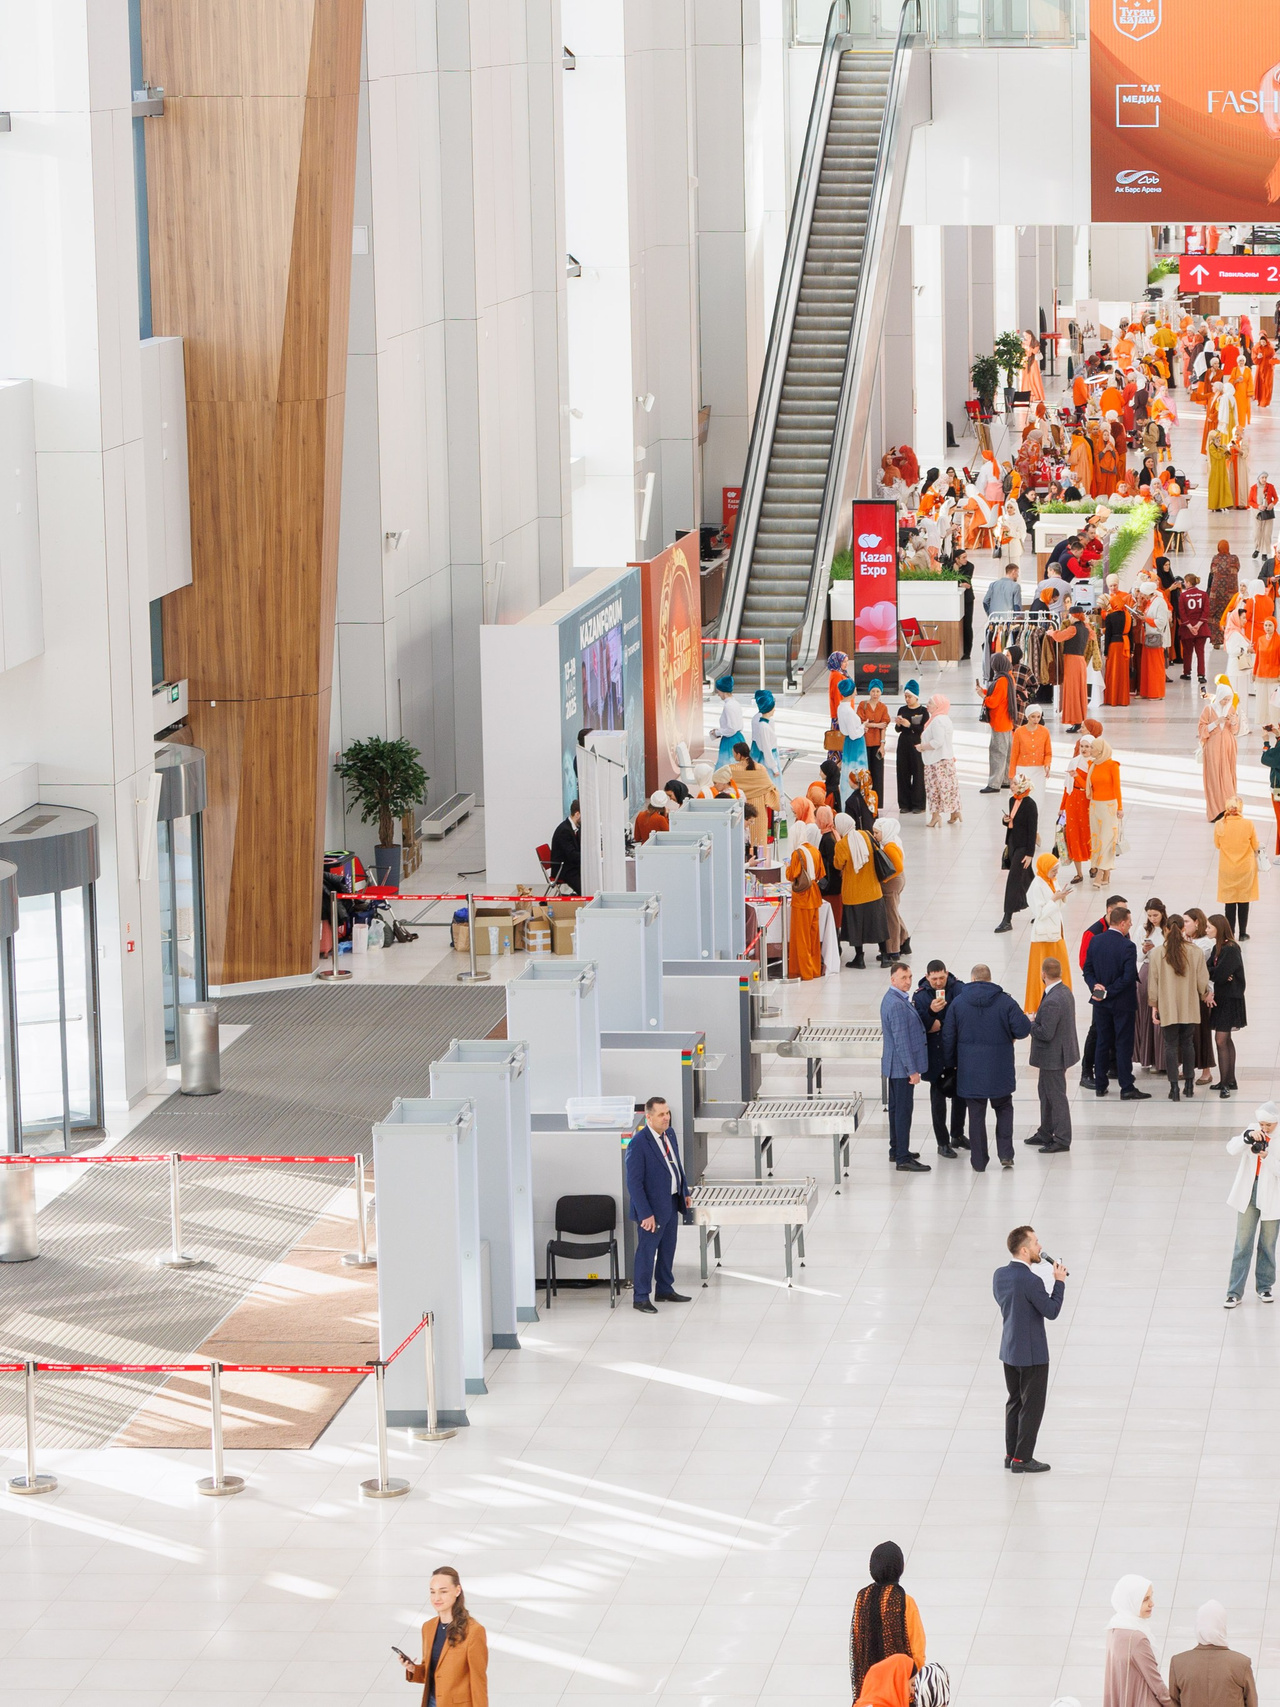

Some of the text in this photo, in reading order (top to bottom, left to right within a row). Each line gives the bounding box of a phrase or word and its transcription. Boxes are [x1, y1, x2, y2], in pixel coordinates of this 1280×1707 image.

[1140, 84, 1161, 92] ТАТ
[1122, 94, 1162, 105] МЕДИА
[860, 551, 893, 563] Kazan
[860, 564, 887, 578] Expo
[1188, 599, 1202, 609] 01
